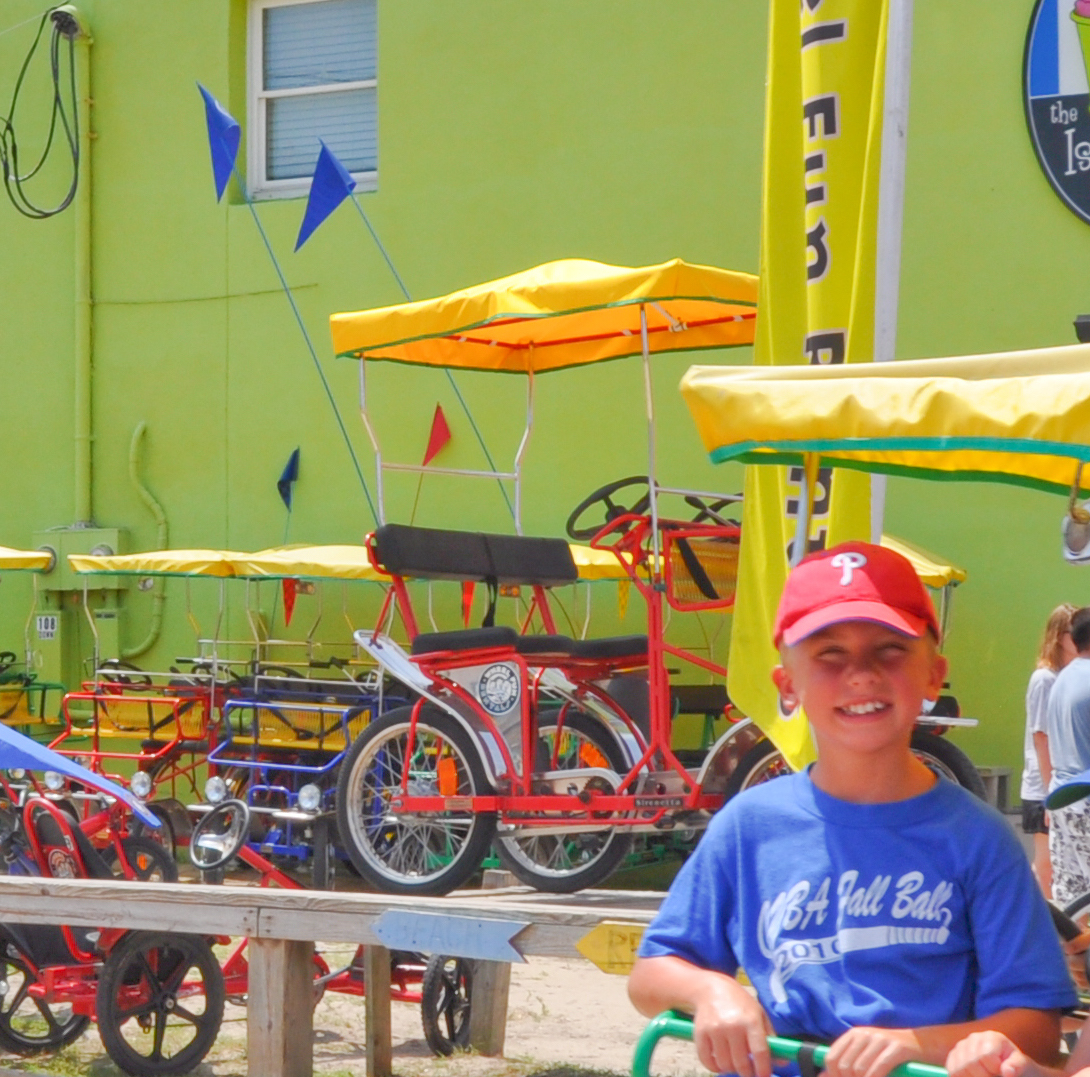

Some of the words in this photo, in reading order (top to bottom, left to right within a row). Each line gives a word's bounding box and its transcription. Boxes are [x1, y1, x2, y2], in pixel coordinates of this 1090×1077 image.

[1050, 101, 1078, 125] the
[831, 551, 868, 587] P
[38, 616, 56, 630] 108
